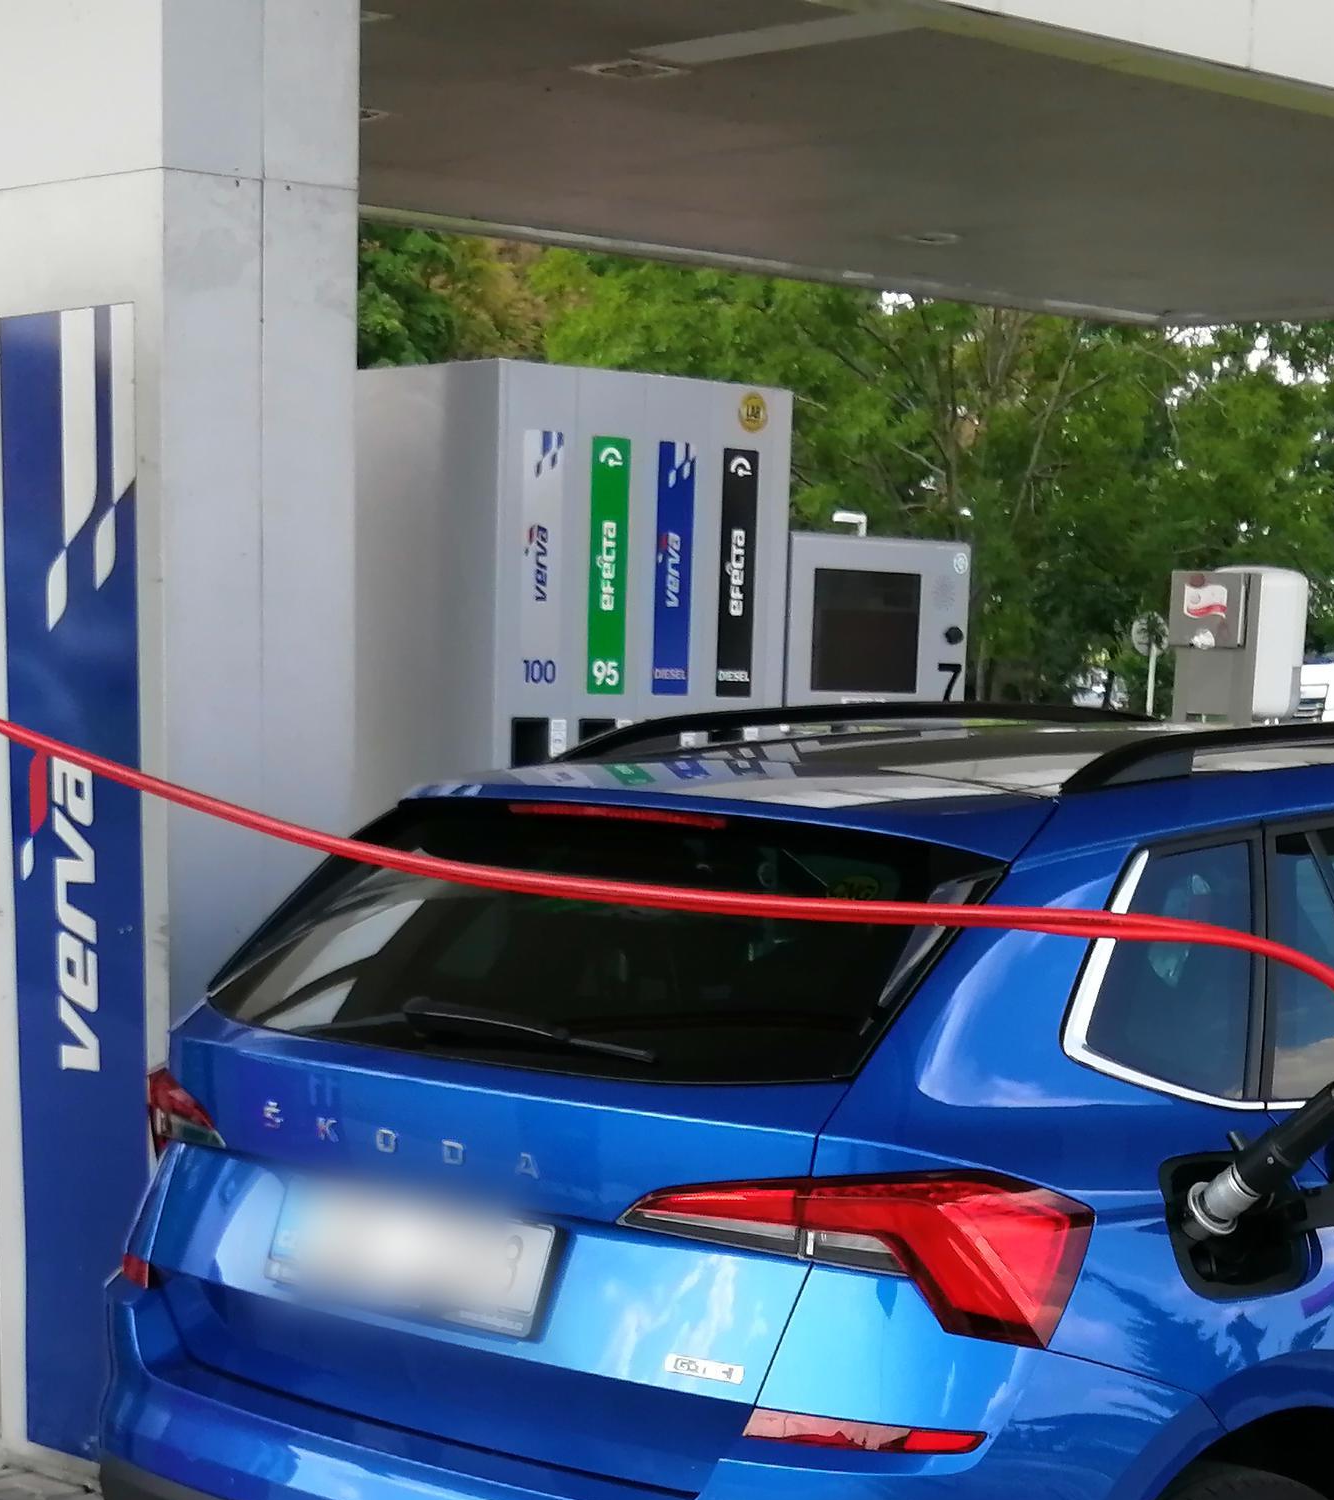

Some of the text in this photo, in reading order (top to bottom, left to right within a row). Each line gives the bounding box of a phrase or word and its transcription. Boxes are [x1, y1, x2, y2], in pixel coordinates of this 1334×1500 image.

[532, 523, 550, 602] verva
[666, 531, 681, 608] verva
[523, 658, 556, 685] 100
[592, 659, 619, 687] 95
[653, 667, 687, 682] DIESEL
[718, 668, 750, 682] DIESEL
[937, 663, 962, 701] 7
[51, 757, 100, 1072] verva
